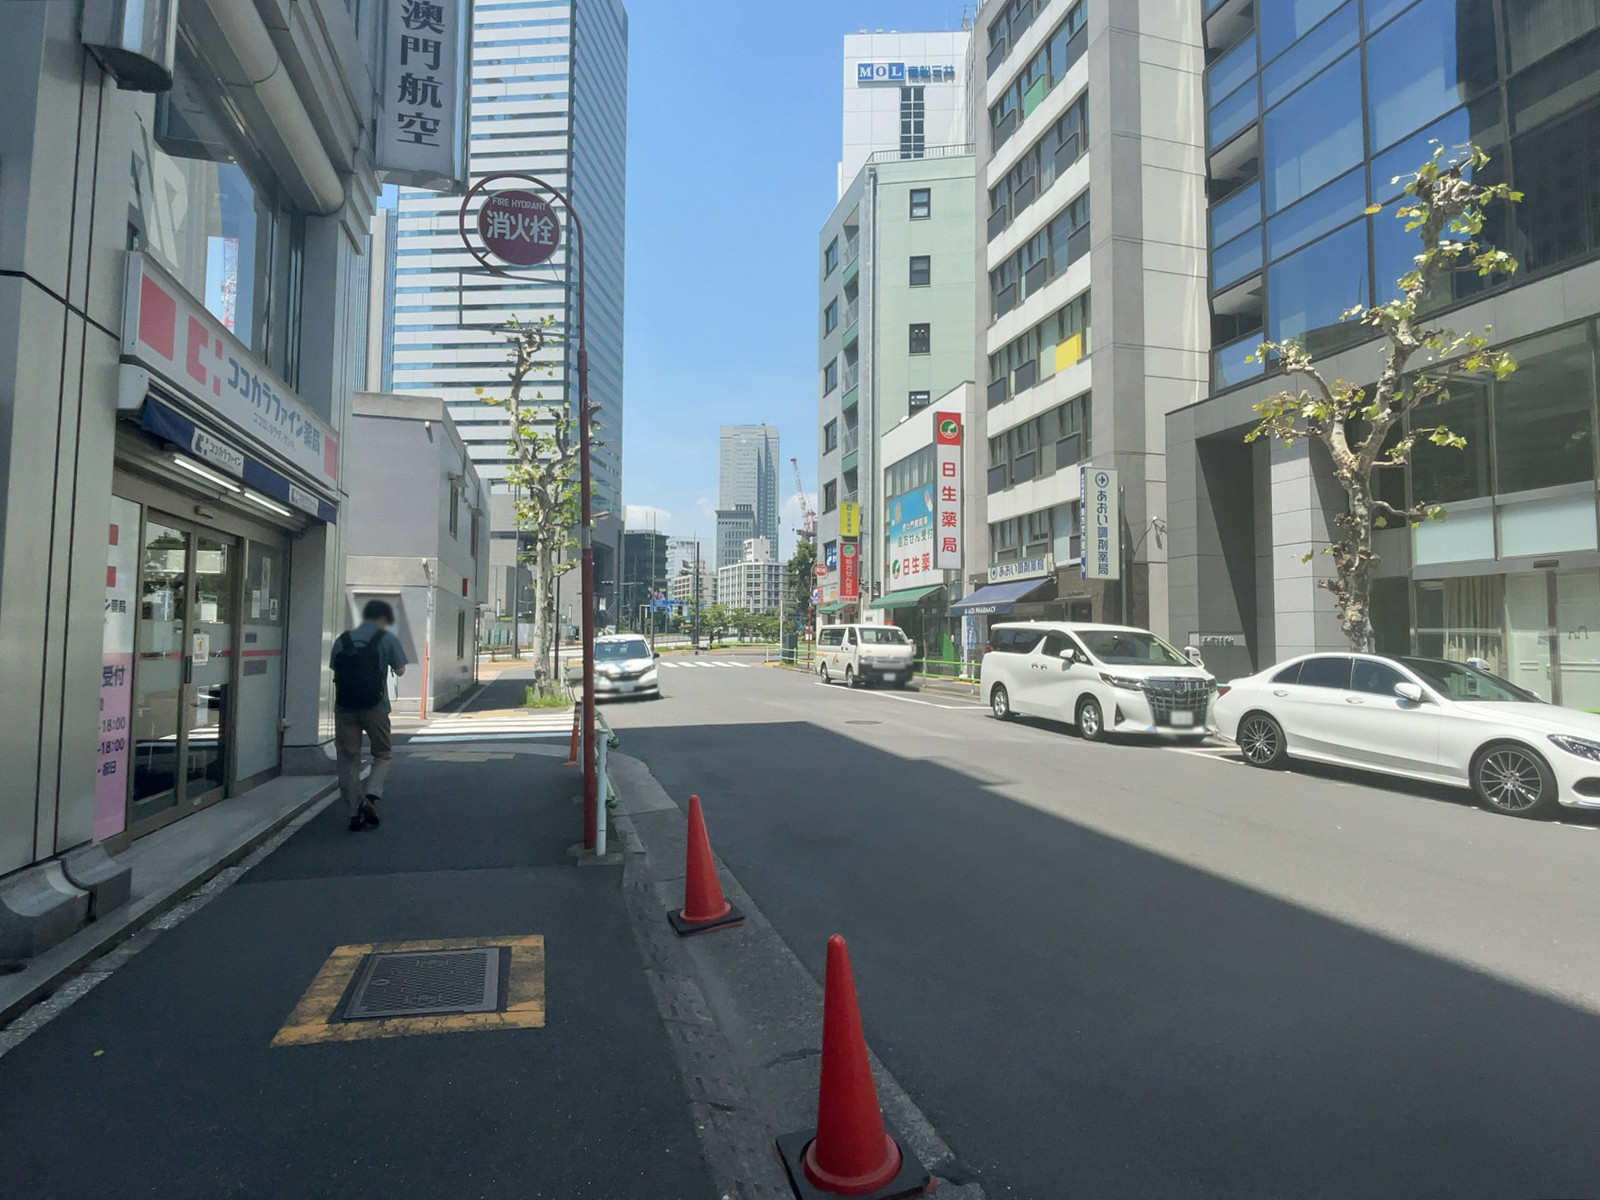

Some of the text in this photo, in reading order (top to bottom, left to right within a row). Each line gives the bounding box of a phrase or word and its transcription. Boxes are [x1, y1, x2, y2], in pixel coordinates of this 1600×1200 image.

[397, 0, 445, 147] 澳門航空
[859, 65, 903, 78] MOL
[492, 197, 547, 211] FIRE HYDRANT
[487, 209, 554, 245] 消火栓
[227, 356, 320, 456] ココカラファイン薬局
[942, 461, 957, 553] 日生薬局
[1096, 490, 1109, 576] あおい調剤薬局
[998, 558, 1045, 578] あおい調剤薬局
[101, 665, 126, 688] 受付
